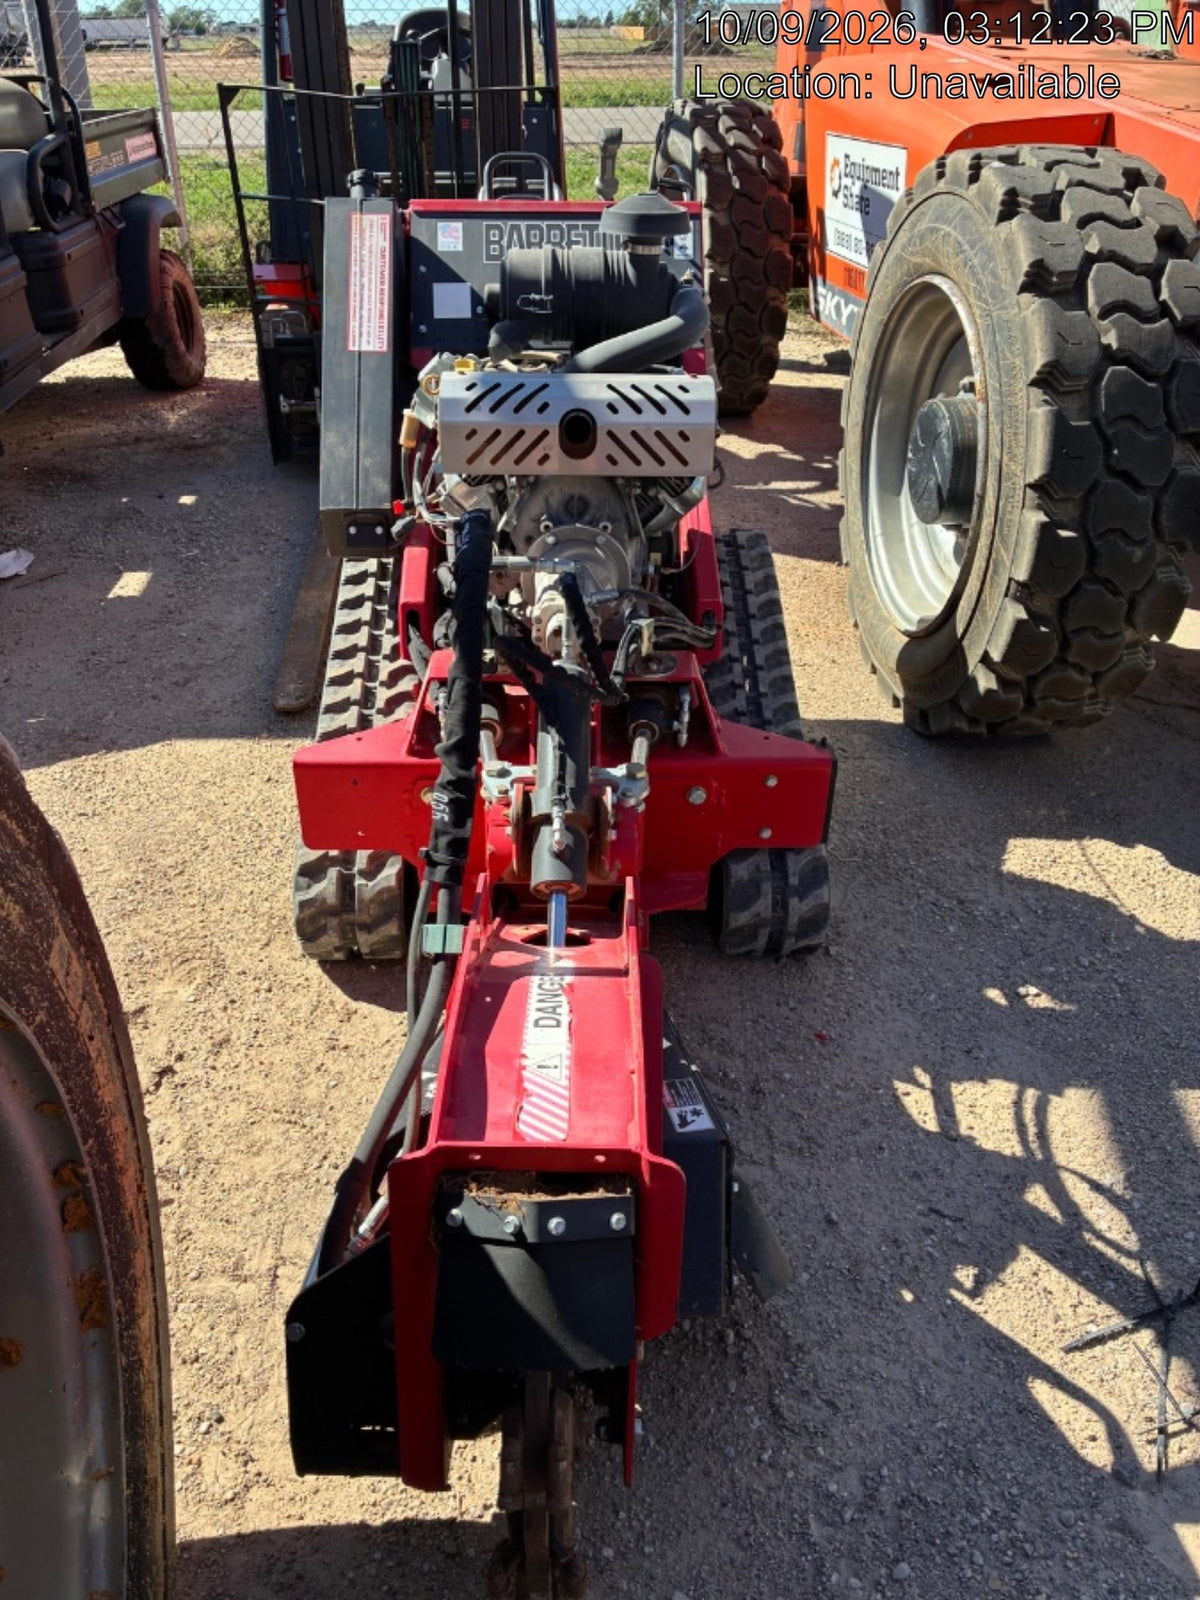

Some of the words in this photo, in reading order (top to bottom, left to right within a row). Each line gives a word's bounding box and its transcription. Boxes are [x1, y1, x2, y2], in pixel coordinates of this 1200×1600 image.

[844, 153, 900, 191] Equipment
[843, 184, 870, 216] Share
[483, 222, 623, 263] BARRET
[379, 245, 387, 286] CUSTOMER
[378, 287, 386, 349] RESPONSIBILITY
[817, 285, 859, 326] SKY
